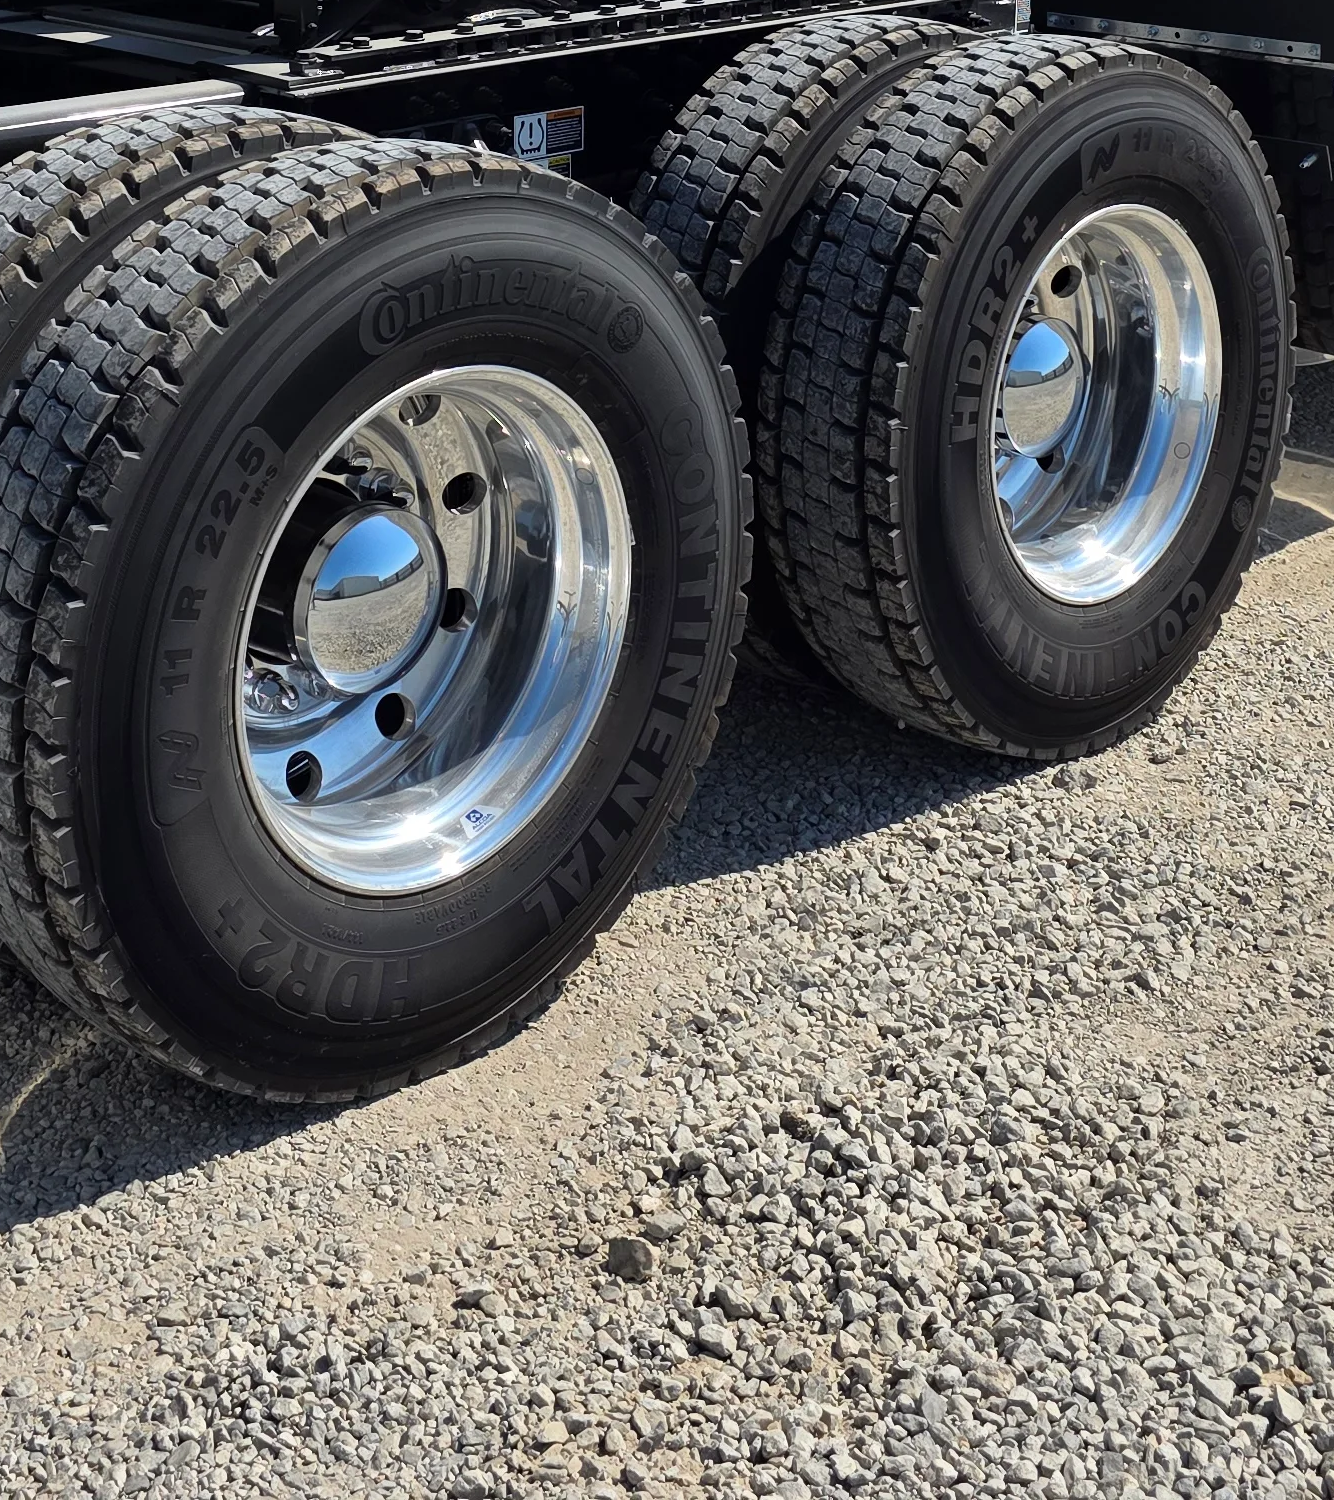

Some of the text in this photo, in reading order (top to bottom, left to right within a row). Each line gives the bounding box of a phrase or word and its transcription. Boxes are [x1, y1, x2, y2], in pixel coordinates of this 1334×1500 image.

[359, 253, 619, 356] Continental
[1239, 245, 1282, 497] Continental
[159, 439, 266, 698] 11 R 22.5
[250, 463, 279, 508] M+S
[524, 402, 720, 944] CONTINENTAL
